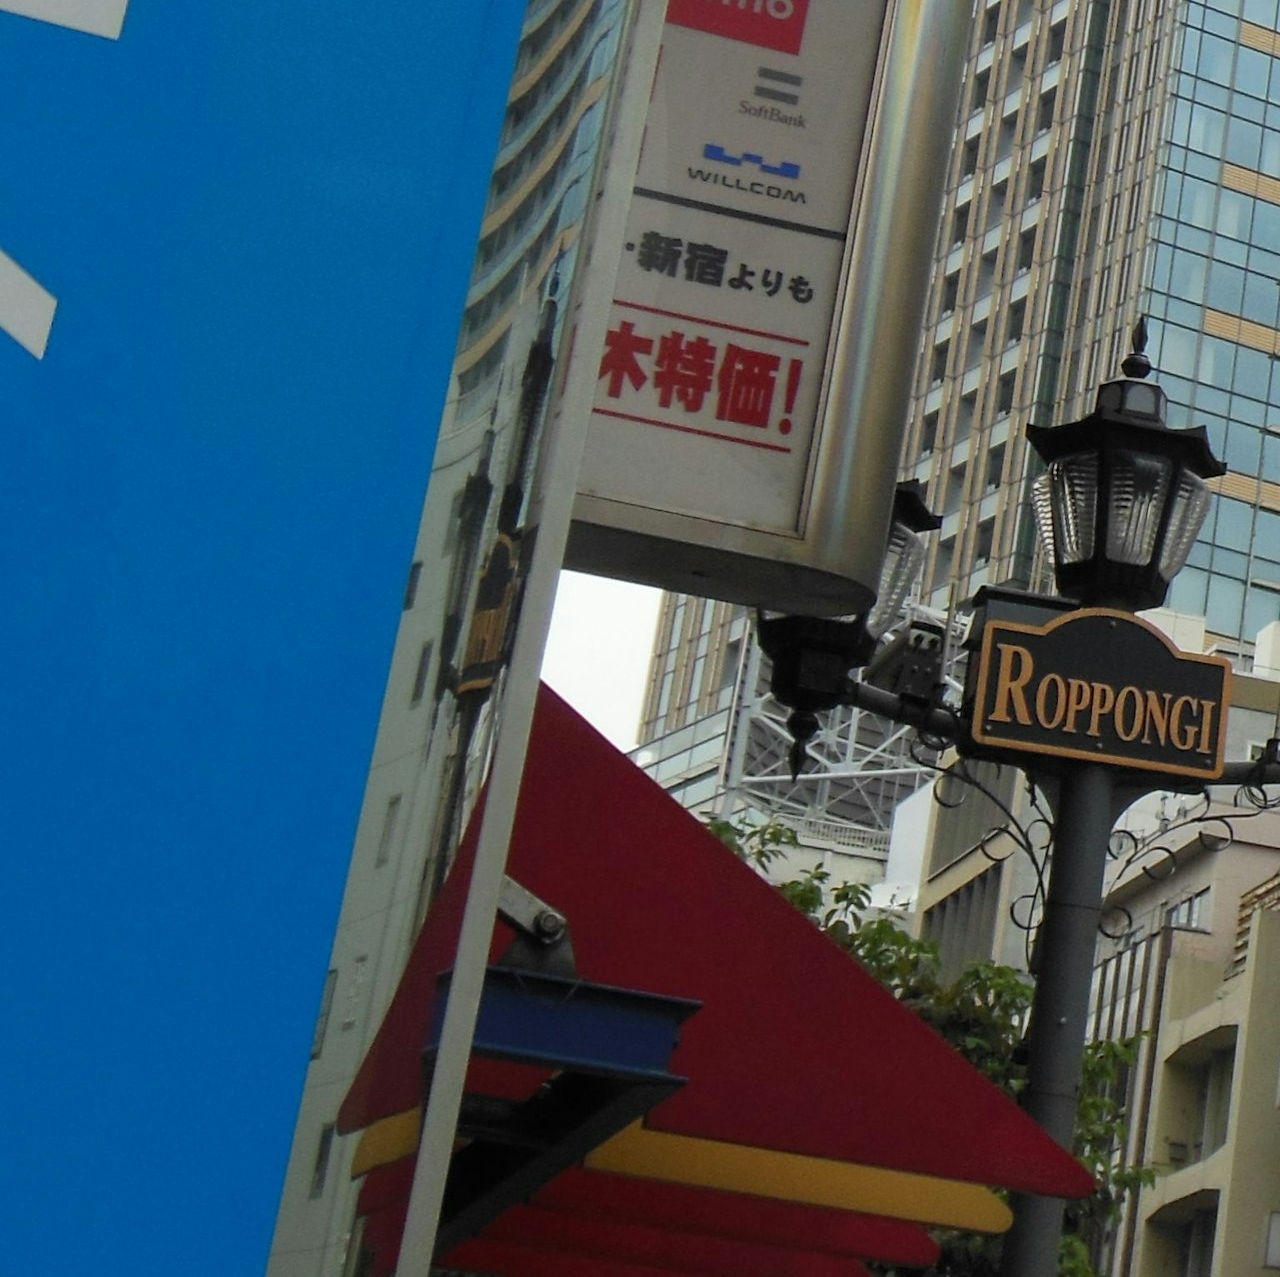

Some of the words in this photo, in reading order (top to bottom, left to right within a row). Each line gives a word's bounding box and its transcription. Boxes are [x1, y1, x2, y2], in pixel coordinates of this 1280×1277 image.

[738, 99, 807, 129] SoftBank
[688, 167, 807, 204] WILLCOM
[987, 642, 1216, 755] ROPPONGI
